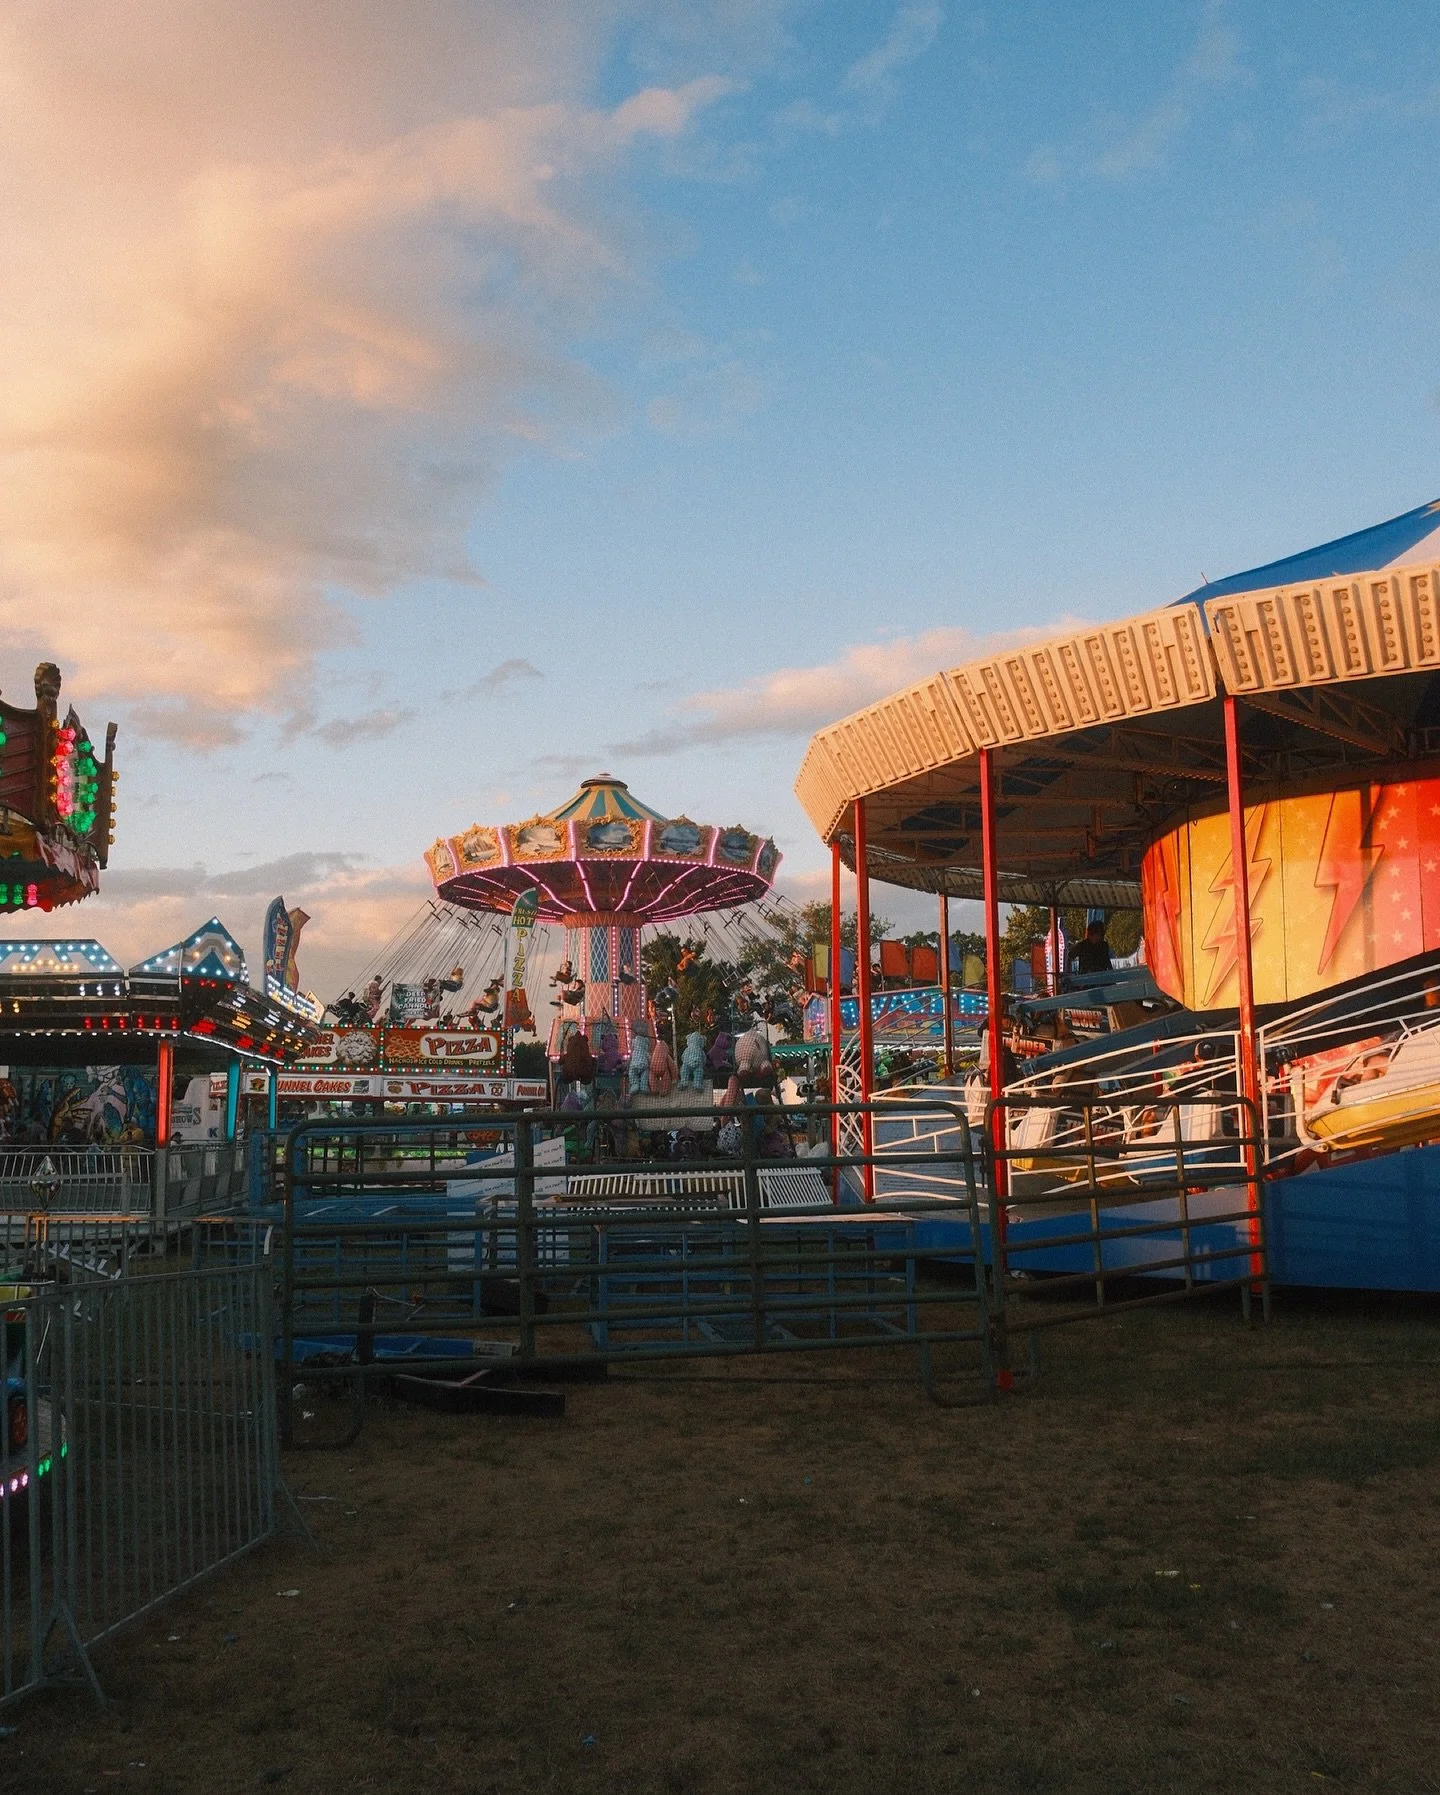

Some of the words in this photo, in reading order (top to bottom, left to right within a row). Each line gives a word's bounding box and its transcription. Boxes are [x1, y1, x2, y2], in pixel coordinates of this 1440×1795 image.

[513, 916, 535, 926] HOT
[511, 927, 528, 1002] PIZZA
[301, 1045, 332, 1059] AKES
[425, 1036, 493, 1056] PIZZA
[277, 1080, 312, 1092] UNNEL
[313, 1079, 352, 1094] CAKES
[406, 1080, 486, 1096] PIZZA
